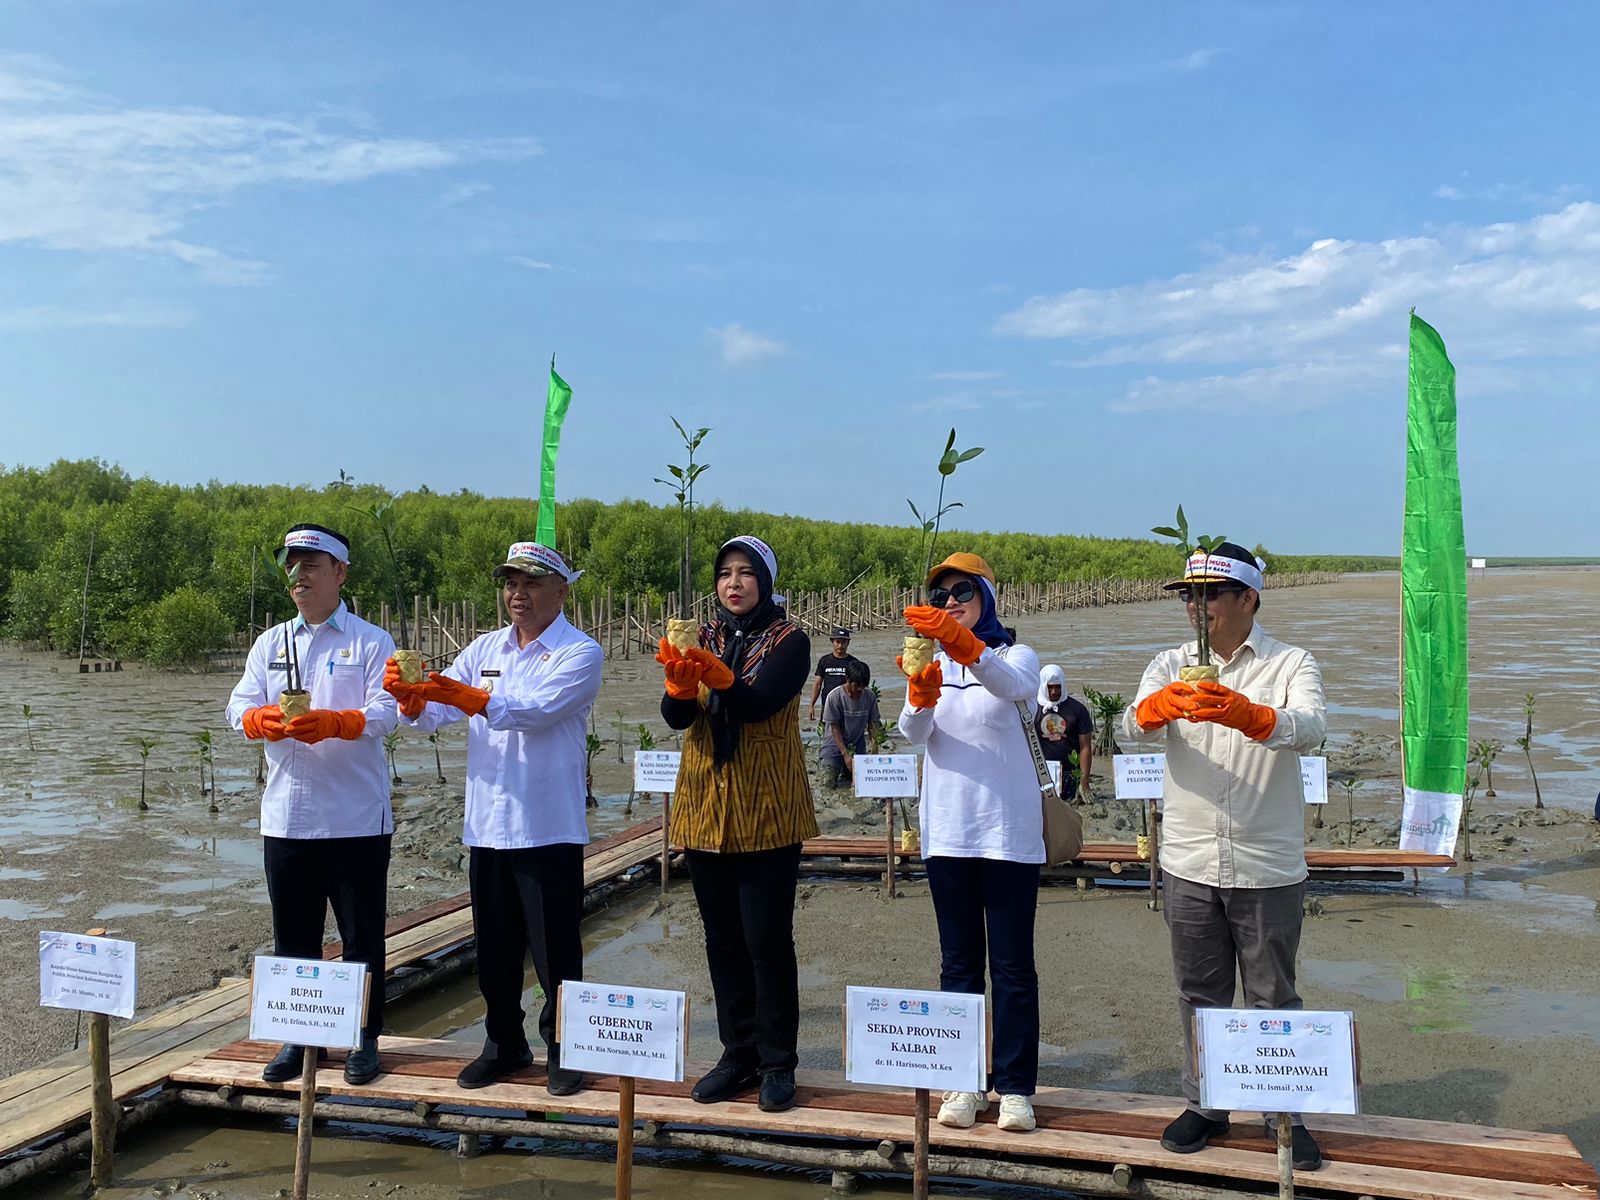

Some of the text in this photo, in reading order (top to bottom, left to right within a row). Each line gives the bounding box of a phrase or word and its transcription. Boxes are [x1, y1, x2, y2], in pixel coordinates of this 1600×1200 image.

[1208, 559, 1232, 569] MUDA
[1026, 719, 1048, 776] EVERBEST
[290, 987, 323, 998] BUPATI
[267, 1000, 345, 1016] KAB. MEMPAWAH
[281, 1017, 289, 1025] Hj.
[290, 1018, 308, 1027] Erlina,
[589, 1015, 653, 1031] GUBERNUR
[598, 1029, 643, 1043] KALBAR
[867, 1023, 961, 1040] SEKDA PROVINSI
[574, 1043, 585, 1051] Drs.
[596, 1045, 606, 1053] Ris
[607, 1047, 631, 1056] Norsan,
[632, 1050, 651, 1059] M.M.,
[891, 1042, 937, 1055] KALBAR
[1256, 1047, 1296, 1058] SEKDA
[886, 1059, 894, 1067] H.
[896, 1060, 929, 1071] Harisson,
[930, 1063, 952, 1071] M.Kes
[1224, 1064, 1328, 1077] KAB. MEMPAWAH
